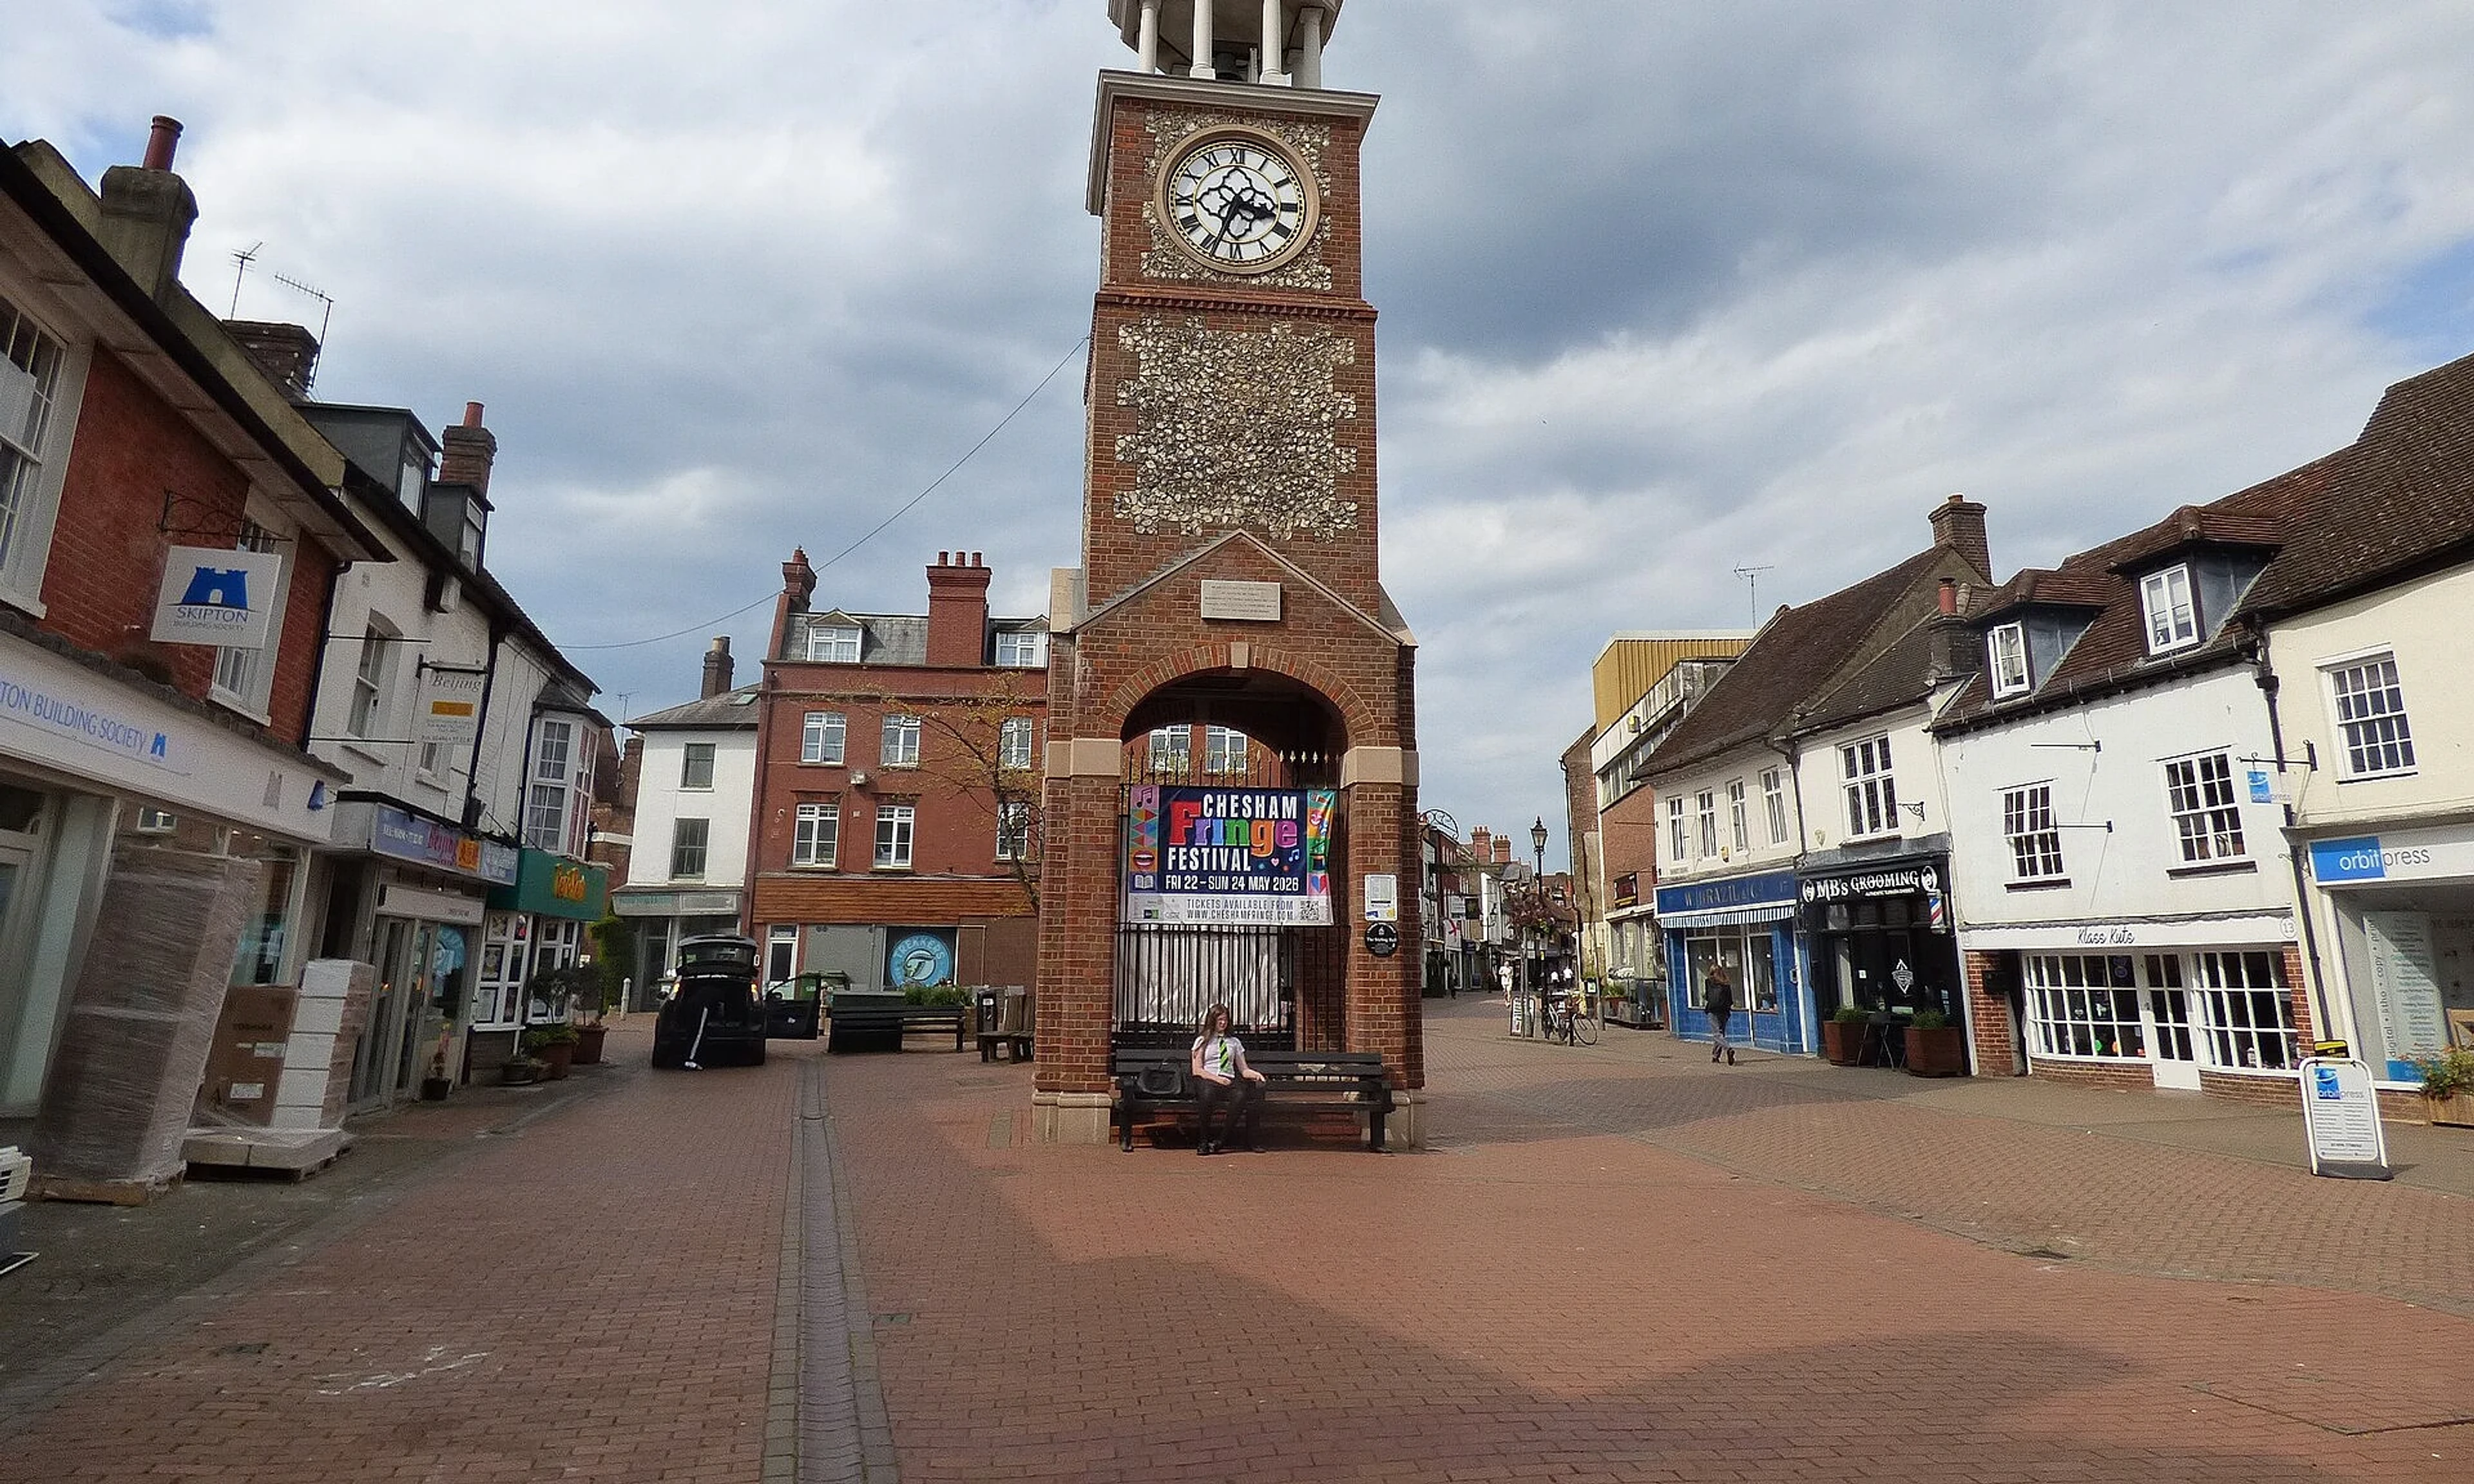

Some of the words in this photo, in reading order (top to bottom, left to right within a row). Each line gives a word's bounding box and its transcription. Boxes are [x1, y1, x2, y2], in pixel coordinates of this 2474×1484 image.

[177, 606, 249, 623] SKIPTON
[431, 675, 482, 692] Beijing
[0, 681, 32, 712] TON
[34, 694, 98, 736] BUILDING
[99, 718, 148, 755] SOCIETY
[1203, 793, 1298, 819] CHESHAM
[1168, 800, 1298, 858] Fringe
[1167, 847, 1252, 872] FESTIVAL
[2339, 848, 2430, 870] orbitpress
[1165, 875, 1181, 889] FRI
[1184, 875, 1198, 890] 22
[1208, 875, 1229, 890] SUN
[1232, 875, 1245, 891] 24
[1248, 876, 1271, 891] MAY
[1816, 879, 1848, 901] MB's
[1850, 870, 1919, 893] GROOMING
[1187, 899, 1222, 909] TICKETS
[1224, 899, 1267, 909] AVAILABLE
[1271, 900, 1293, 910] FROM
[2077, 928, 2107, 944] Klass
[2109, 927, 2135, 944] Kuts
[897, 937, 946, 960] TREKKERS
[2375, 955, 2384, 977] copy
[2384, 1026, 2396, 1057] digital
